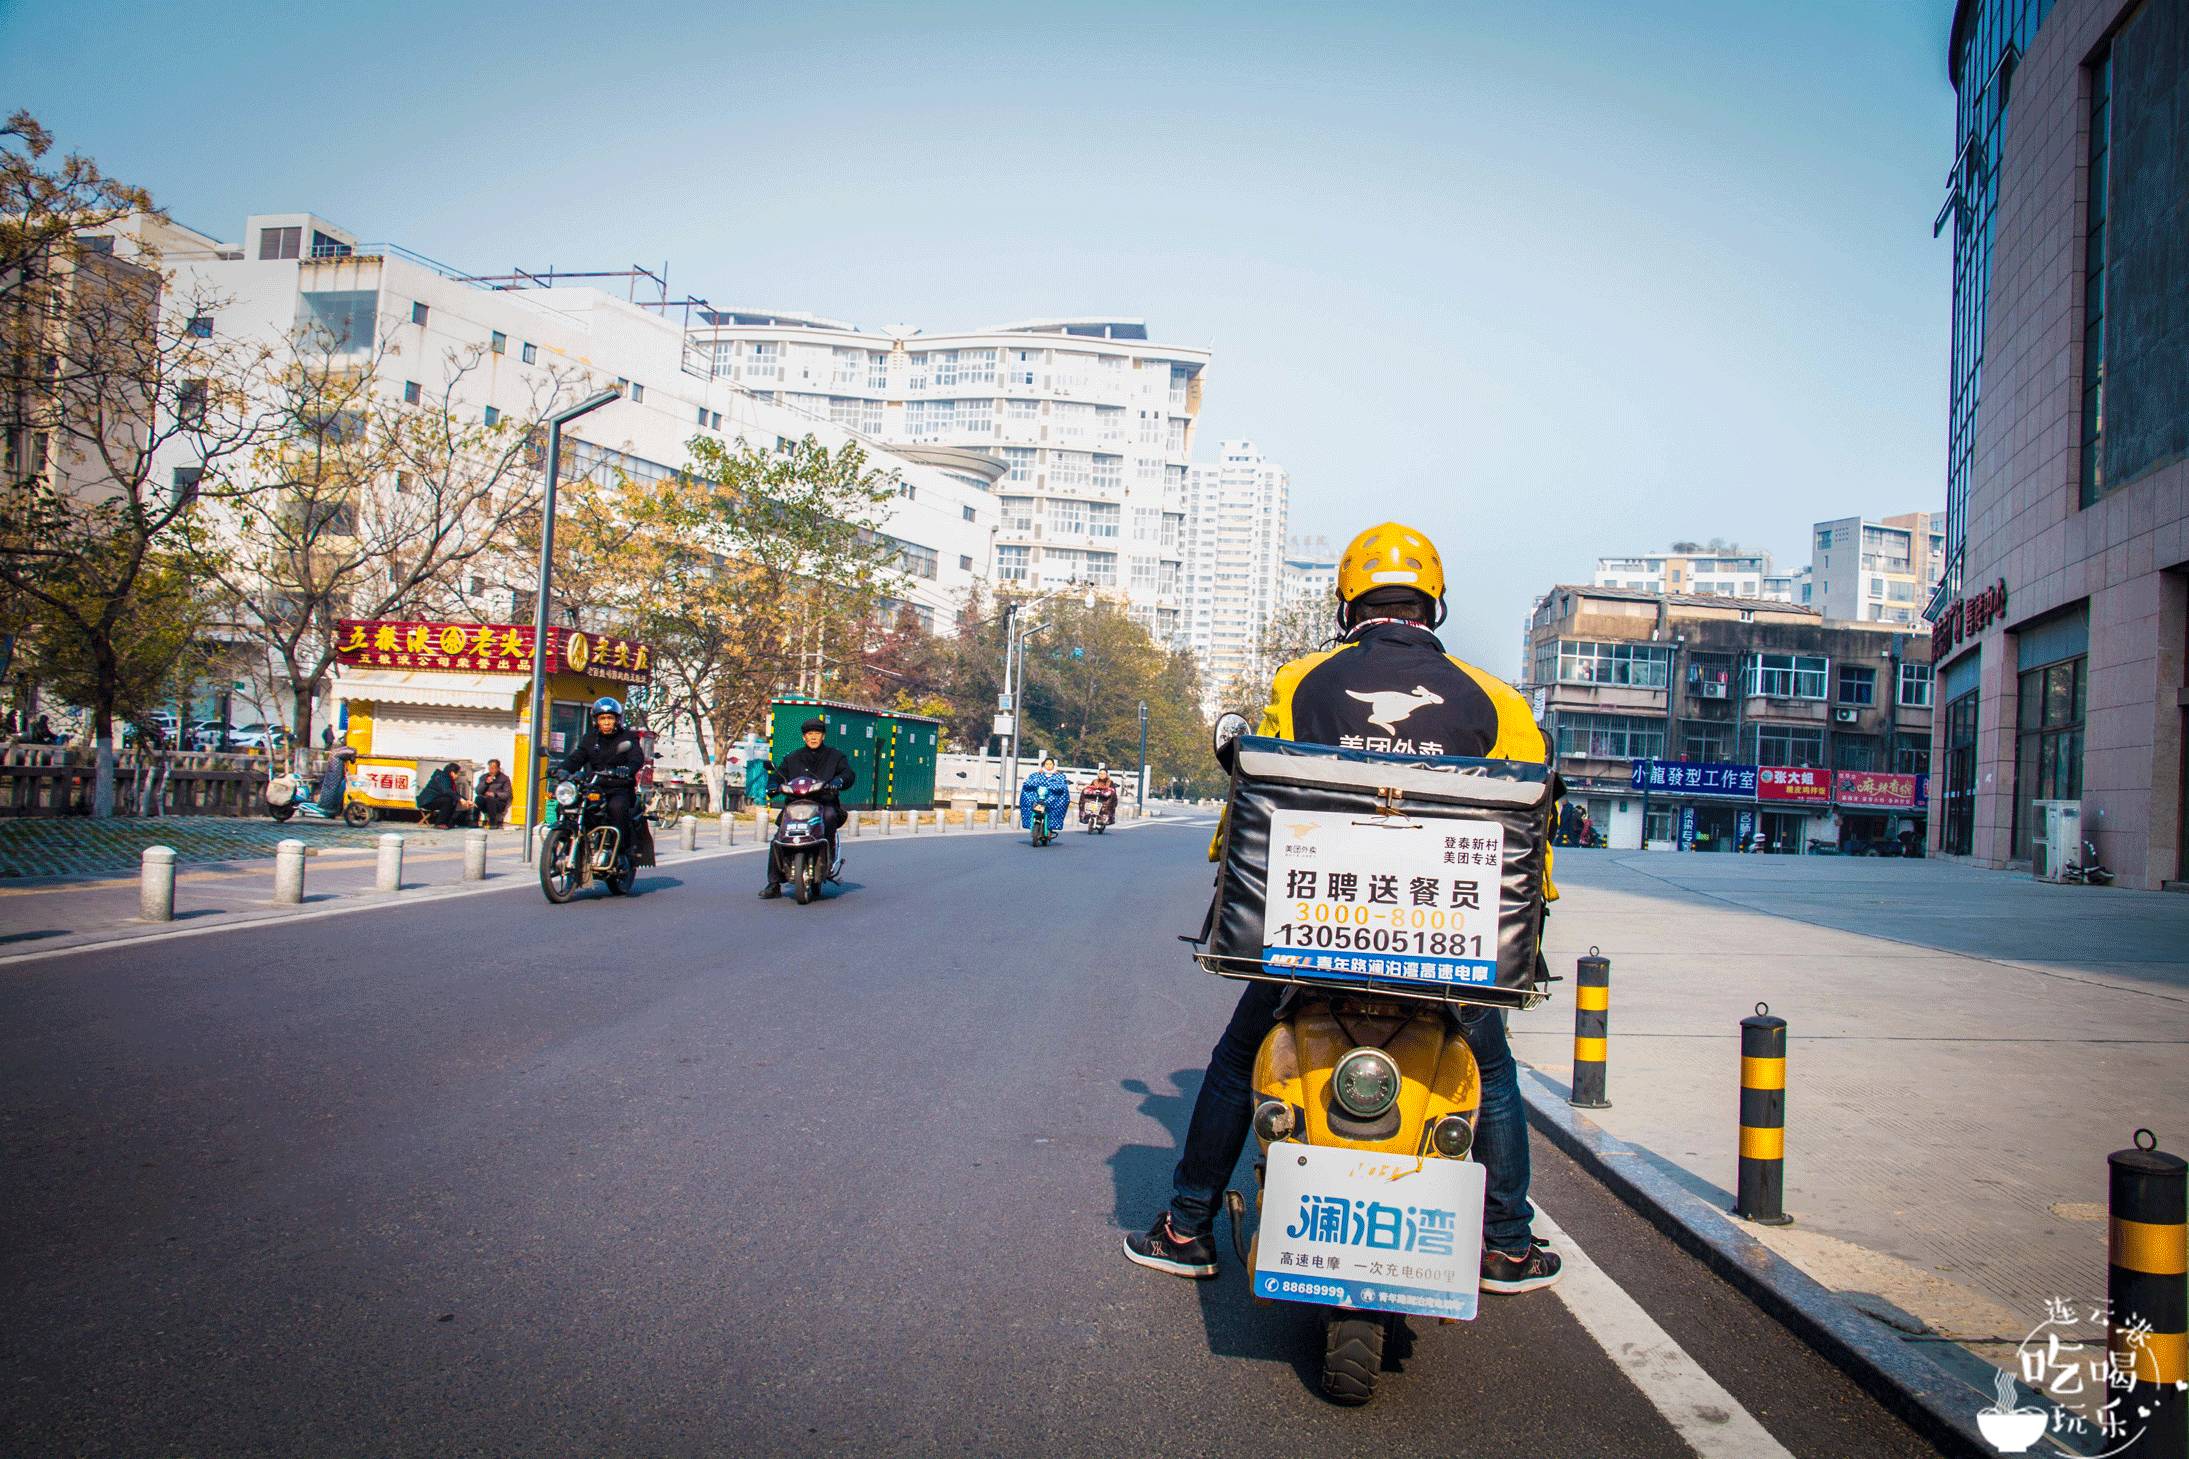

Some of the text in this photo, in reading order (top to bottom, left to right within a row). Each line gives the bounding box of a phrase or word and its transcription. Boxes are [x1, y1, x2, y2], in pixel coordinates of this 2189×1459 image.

[339, 624, 435, 655] 五粮液
[358, 653, 532, 671] 五粮液公司荣誉出品
[1339, 734, 1444, 756] 美团外卖
[1632, 764, 1755, 790] 小龍發型工作室
[1774, 770, 1814, 785] 张大姐
[1285, 844, 1318, 855] 美团外卖
[1444, 836, 1499, 852] 登泰新村
[1443, 850, 1498, 867] 美团专送
[1286, 869, 1480, 911] 招聘送餐员
[1296, 901, 1465, 931] 3000-8000
[1280, 923, 1482, 958] 13056051881
[1316, 955, 1489, 982] 青年路澜泊湾高速电摩
[1286, 1194, 1456, 1257] 澜泊湾
[1280, 1251, 1341, 1271] 高速电摩
[1282, 1280, 1345, 1299] 88689999
